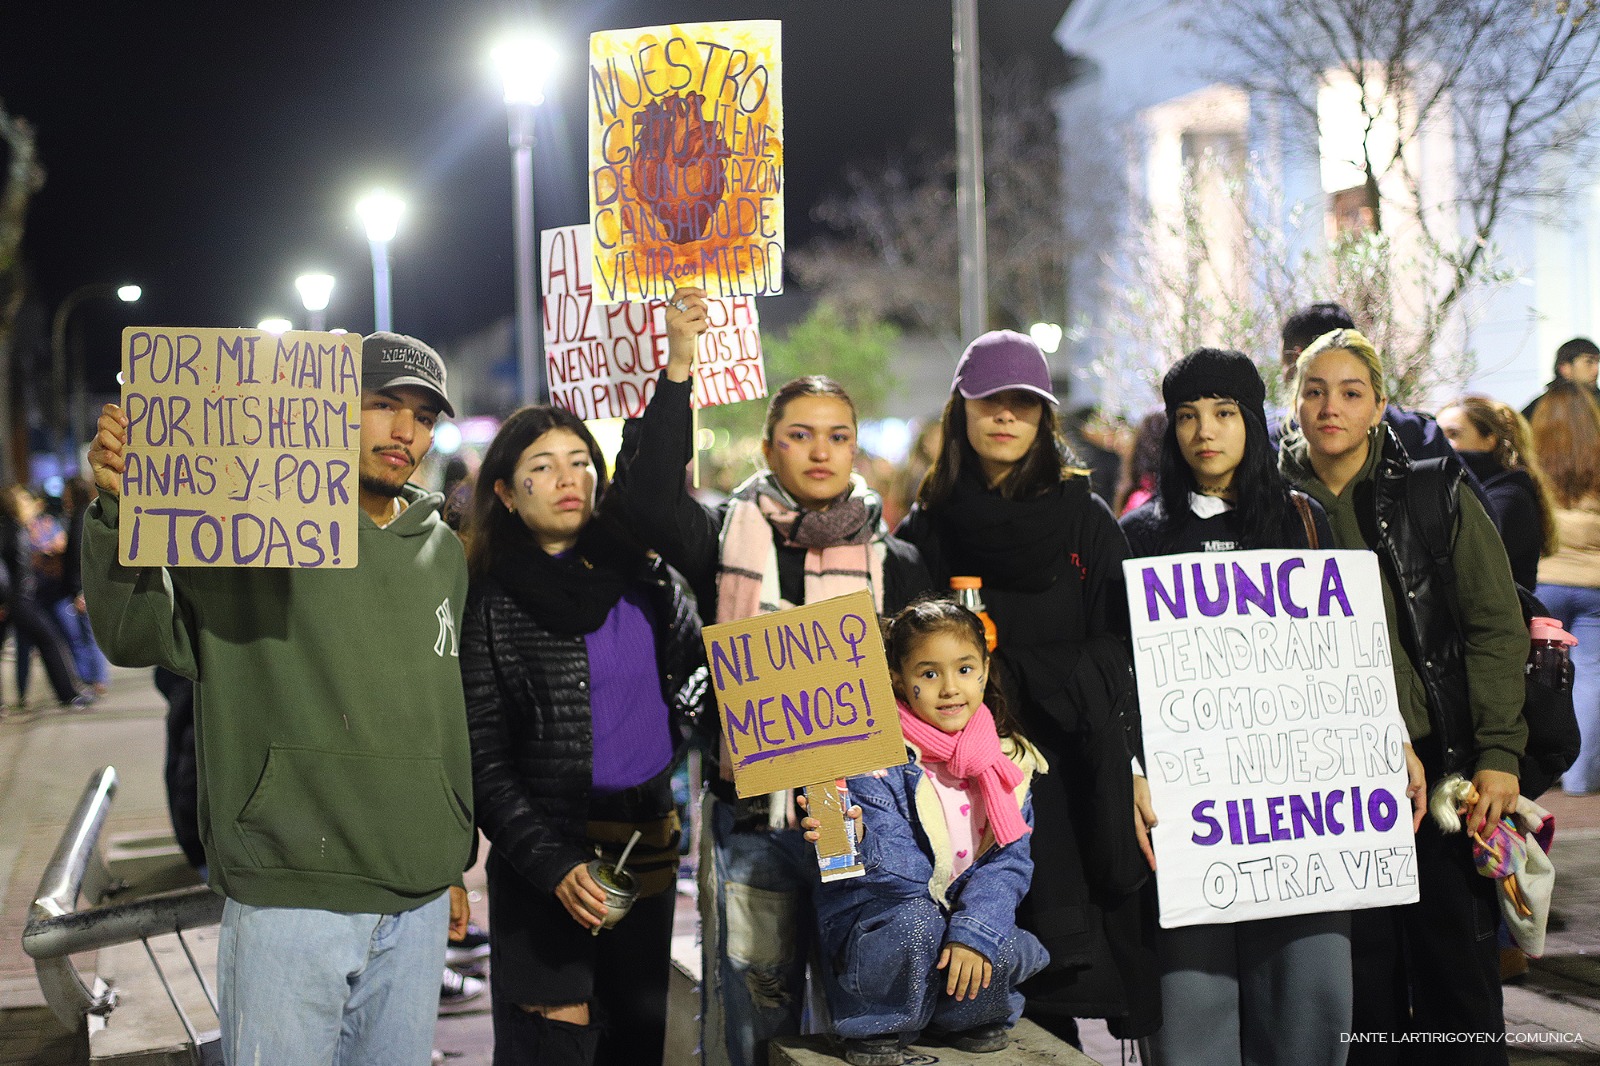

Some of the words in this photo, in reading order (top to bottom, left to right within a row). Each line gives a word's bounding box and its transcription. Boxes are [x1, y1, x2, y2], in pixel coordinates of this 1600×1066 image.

[591, 37, 768, 126] NUESTRO
[602, 98, 690, 165] GRITO
[699, 98, 775, 158] VIENE
[593, 165, 635, 205] DE
[643, 161, 678, 200] UN
[594, 199, 731, 249] CANSADO
[737, 197, 777, 239] DE
[595, 247, 677, 304] VIVIR
[701, 242, 784, 297] MIEDO
[129, 332, 202, 386] POR
[216, 336, 261, 385] MI
[273, 341, 359, 397] MAMA
[549, 342, 610, 387] NENA
[613, 335, 669, 376] QUE
[126, 392, 195, 447] POR
[204, 395, 262, 446] MIS
[269, 395, 361, 450] HERM-
[123, 452, 219, 497] ANAS
[274, 453, 350, 506] POR
[128, 506, 341, 568] ¡TODAS!
[1141, 557, 1354, 622] NUNCA
[711, 633, 760, 691] NI
[764, 620, 838, 670] UNA
[1350, 619, 1391, 669] LA
[723, 678, 875, 755] MENOS!
[1155, 748, 1210, 786] DE
[1226, 723, 1405, 785] NUESTRO
[1191, 786, 1398, 846] SILENCIO
[1202, 852, 1335, 910] OTRA
[1340, 846, 1417, 890] VEZ
